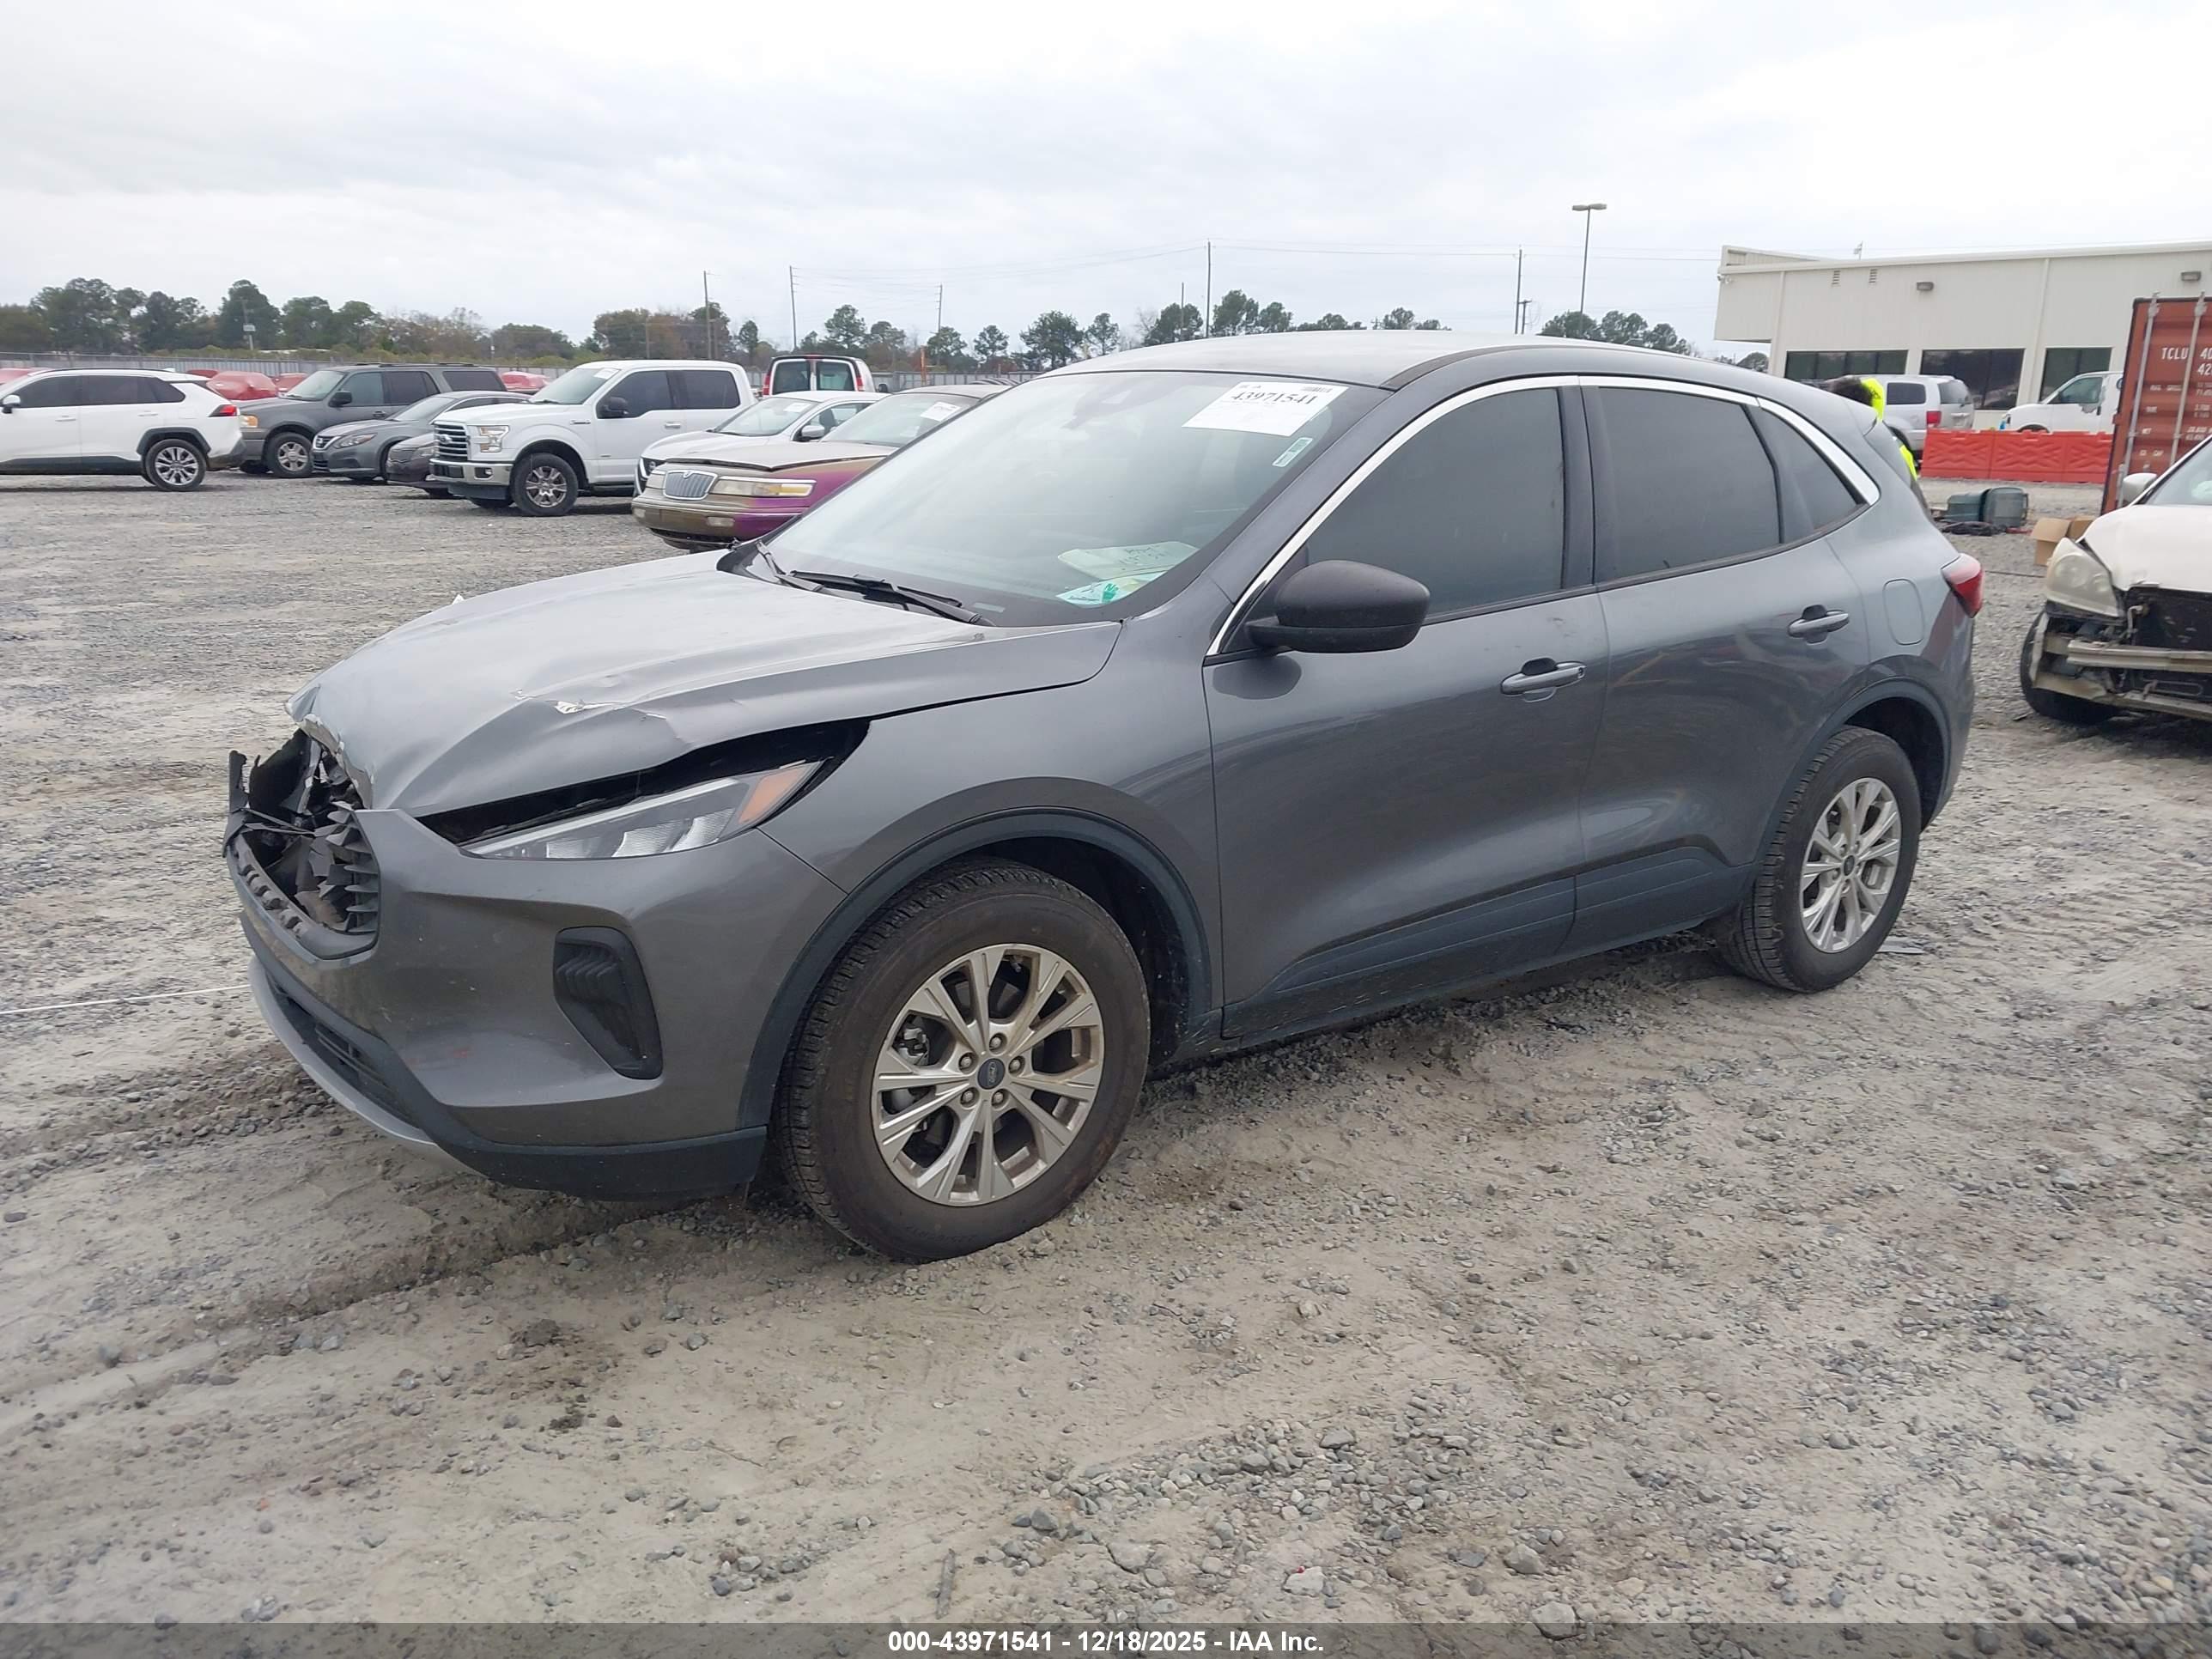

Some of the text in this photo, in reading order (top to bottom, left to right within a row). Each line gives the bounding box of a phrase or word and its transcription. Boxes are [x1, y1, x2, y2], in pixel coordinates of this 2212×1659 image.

[2161, 347, 2189, 360] TCLU
[2197, 363, 2212, 376] 42
[1231, 392, 1318, 404] 43971541
